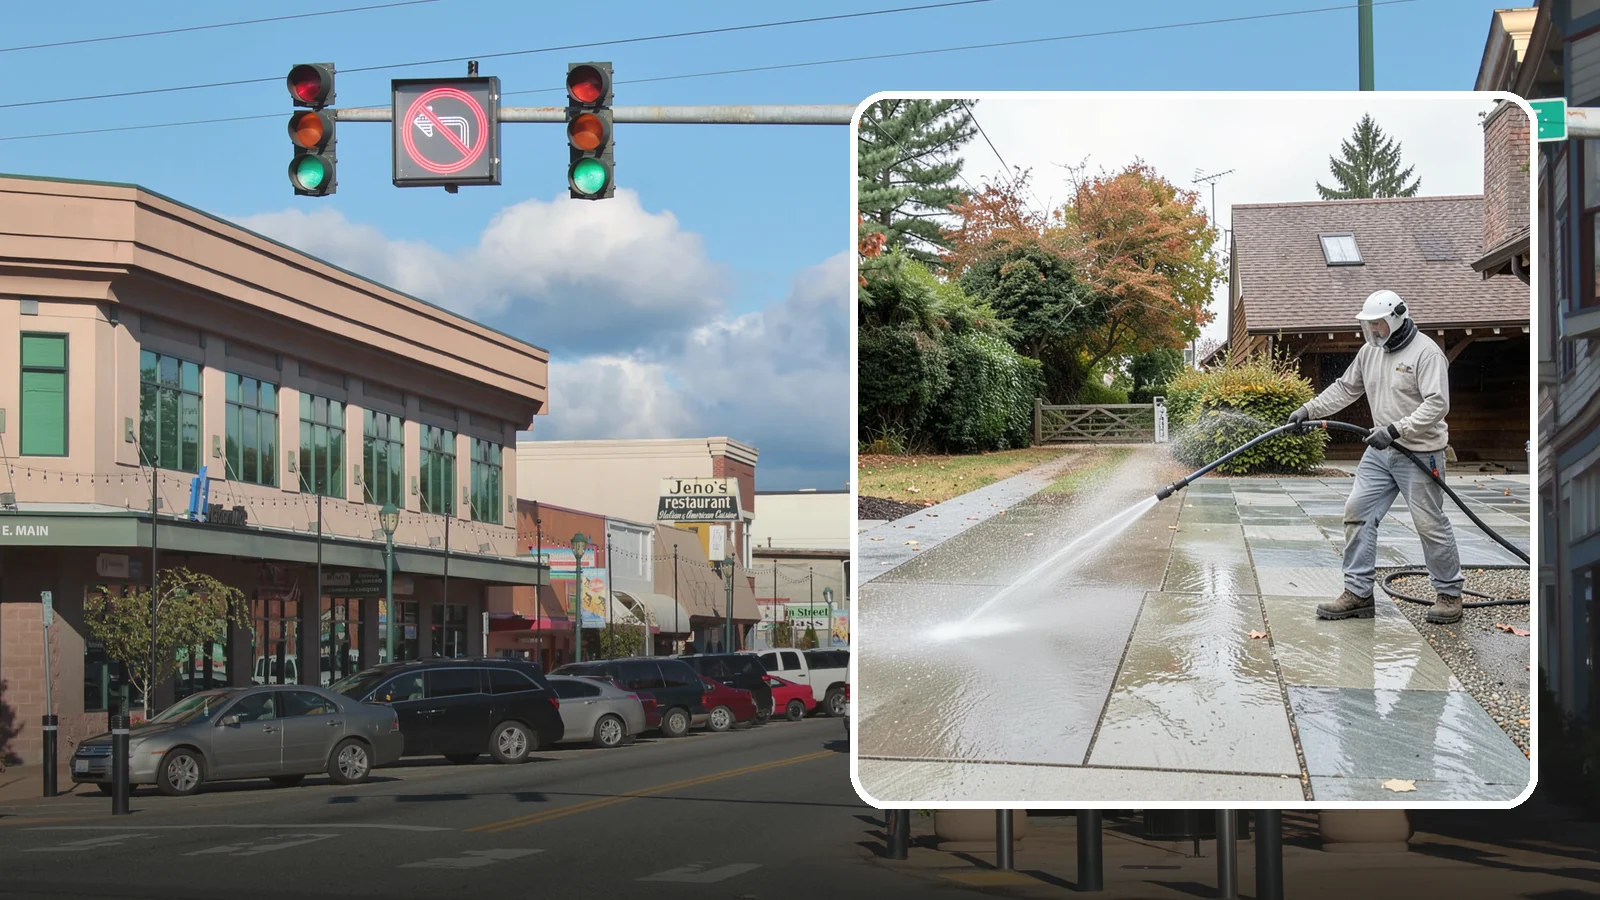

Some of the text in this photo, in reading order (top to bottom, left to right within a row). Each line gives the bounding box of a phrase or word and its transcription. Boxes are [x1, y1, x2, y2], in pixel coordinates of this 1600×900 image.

[669, 480, 727, 494] Jeno's
[665, 496, 731, 509] restaurant
[658, 510, 681, 519] Italian
[686, 510, 714, 519] American
[715, 509, 738, 519] Cuisine
[2, 525, 49, 536] E. MAIN
[797, 607, 828, 617] Street
